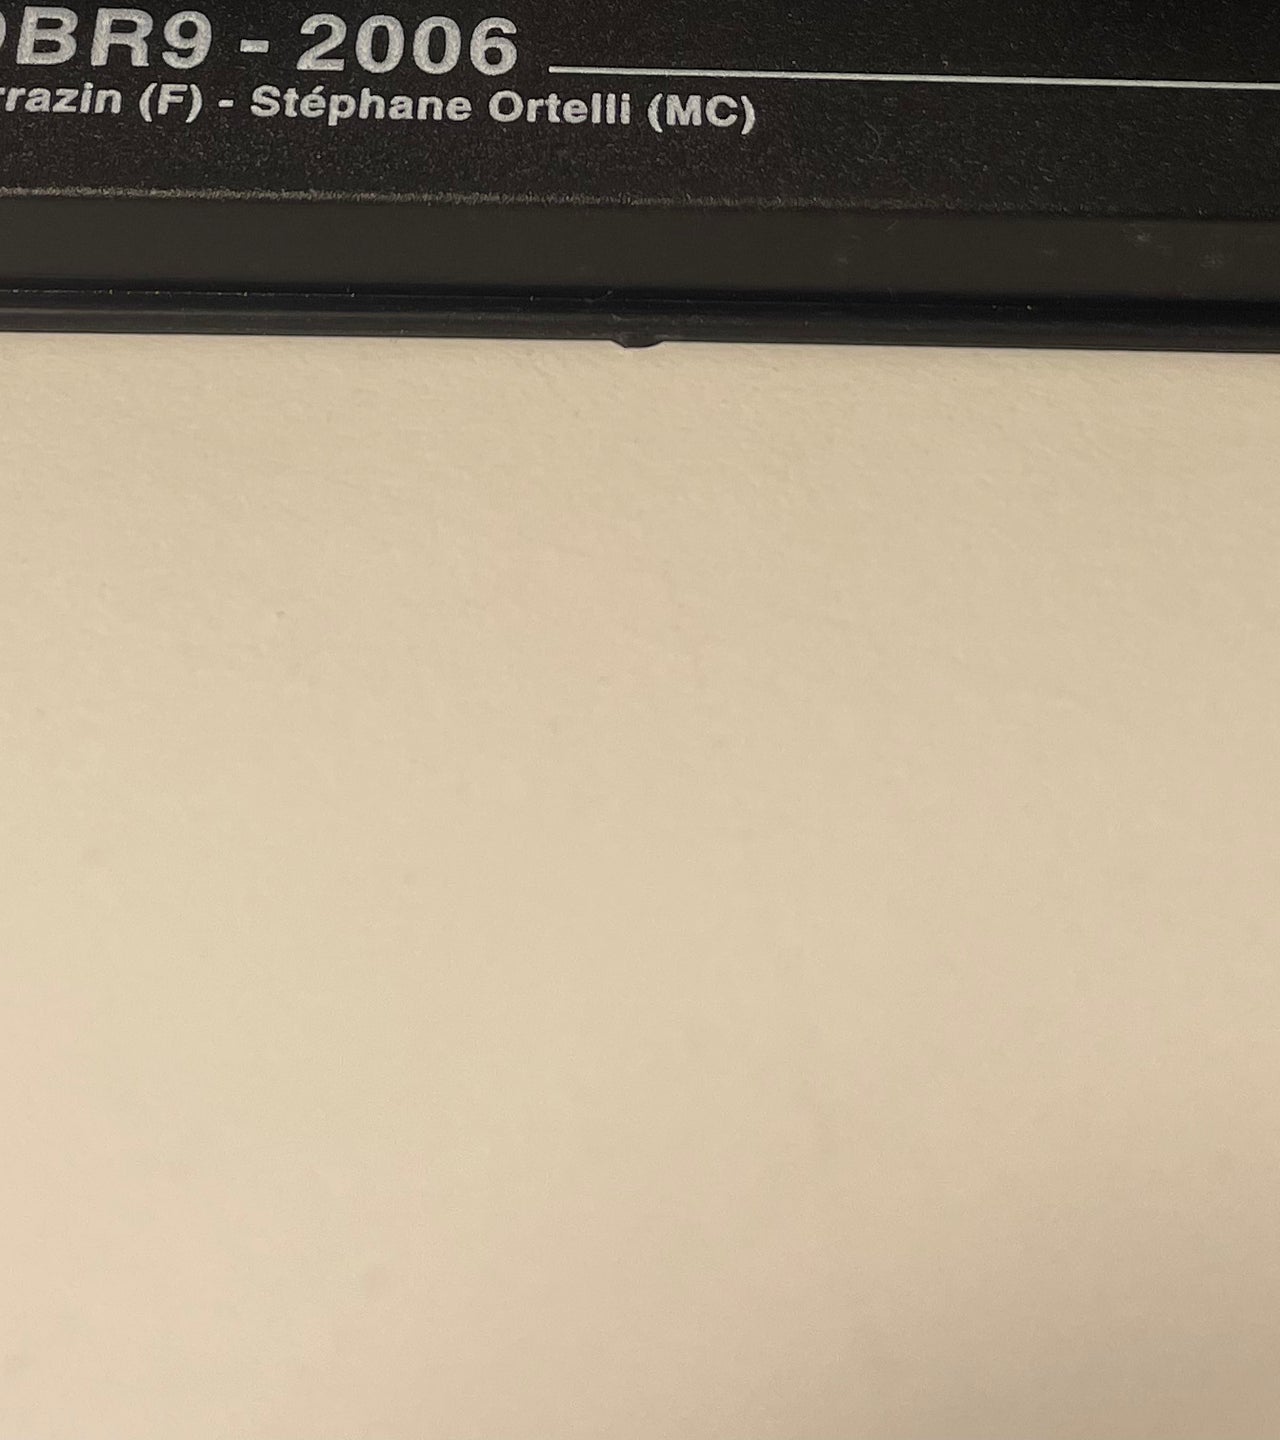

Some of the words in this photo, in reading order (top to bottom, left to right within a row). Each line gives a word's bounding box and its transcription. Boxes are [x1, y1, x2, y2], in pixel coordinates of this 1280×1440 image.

[296, 13, 519, 76] 2006
[139, 82, 204, 123] (F)
[250, 85, 473, 126] Stéphane
[488, 89, 632, 125] Ortelli
[647, 92, 757, 135] (MC)
